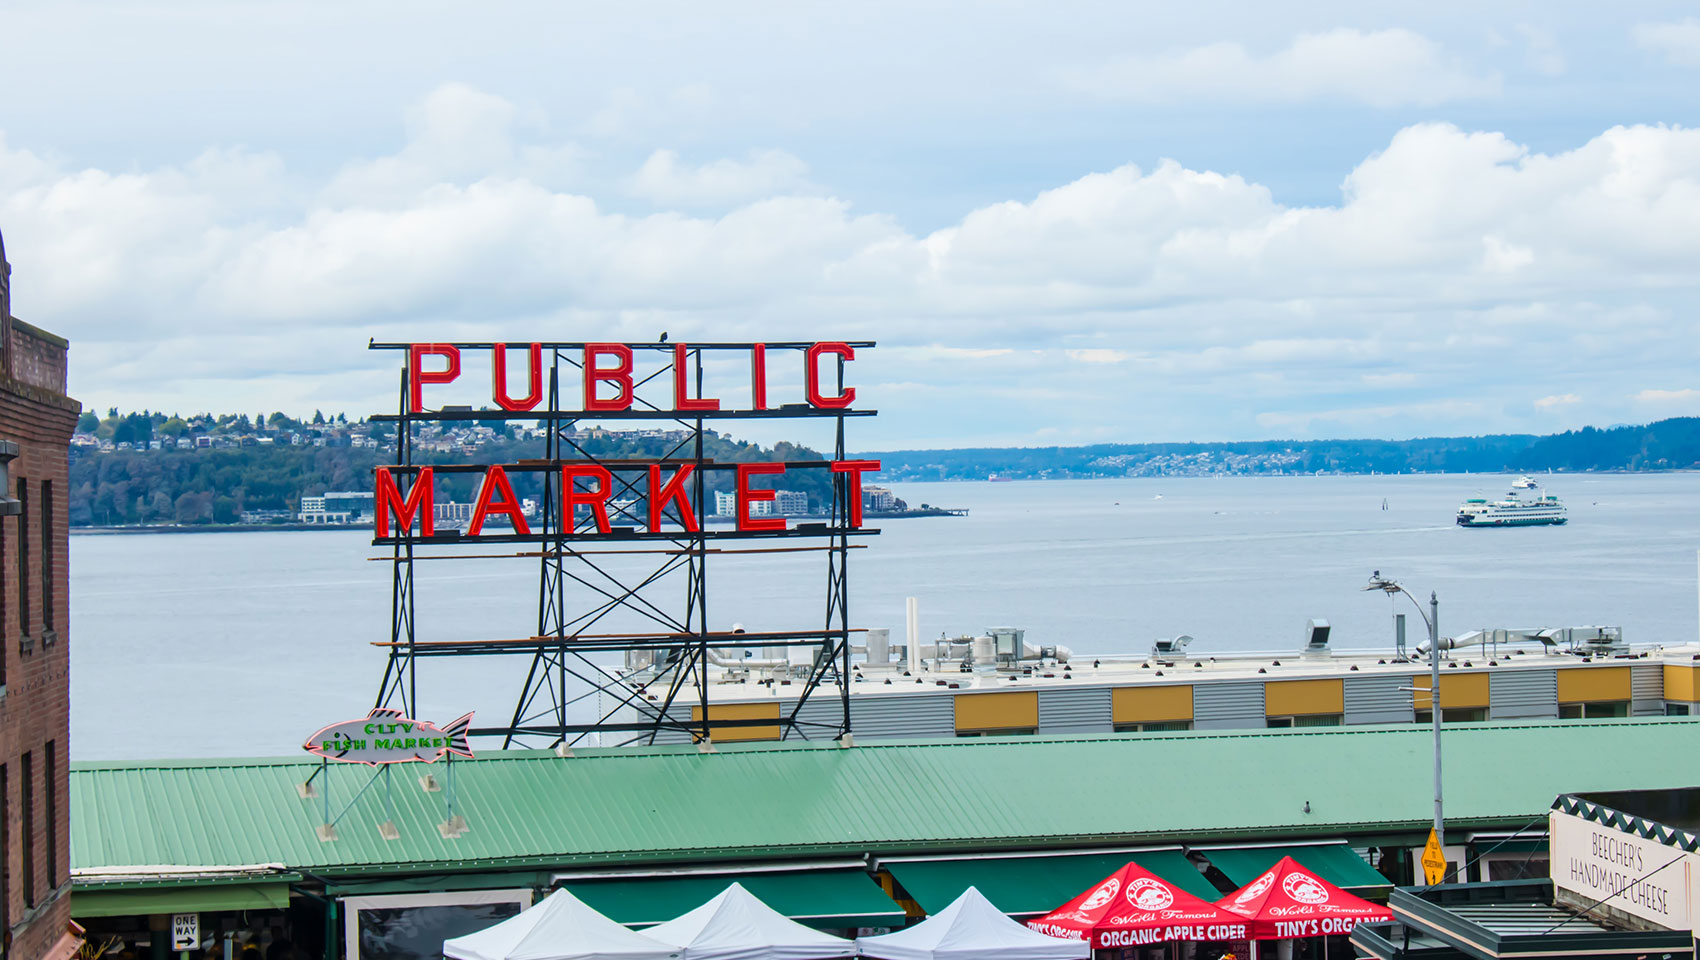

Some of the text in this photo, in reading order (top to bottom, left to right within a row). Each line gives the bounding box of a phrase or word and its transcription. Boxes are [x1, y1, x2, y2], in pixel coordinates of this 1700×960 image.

[408, 341, 856, 413] PUBLIC
[374, 459, 882, 538] MARKET
[364, 723, 414, 735] CITY
[322, 737, 455, 752] FISH MARKET
[1592, 832, 1643, 872] BEECHER'S
[1570, 857, 1668, 915] HANDMADE CHEESE
[1110, 912, 1157, 925] World
[1159, 909, 1217, 920] Famous
[1269, 904, 1315, 917] World
[1318, 903, 1373, 914] Famous
[176, 916, 196, 926] ONE
[1275, 920, 1319, 938] TINY'S
[176, 926, 196, 935] WAY
[1100, 924, 1246, 947] ORGANIC APPLE CIDER
